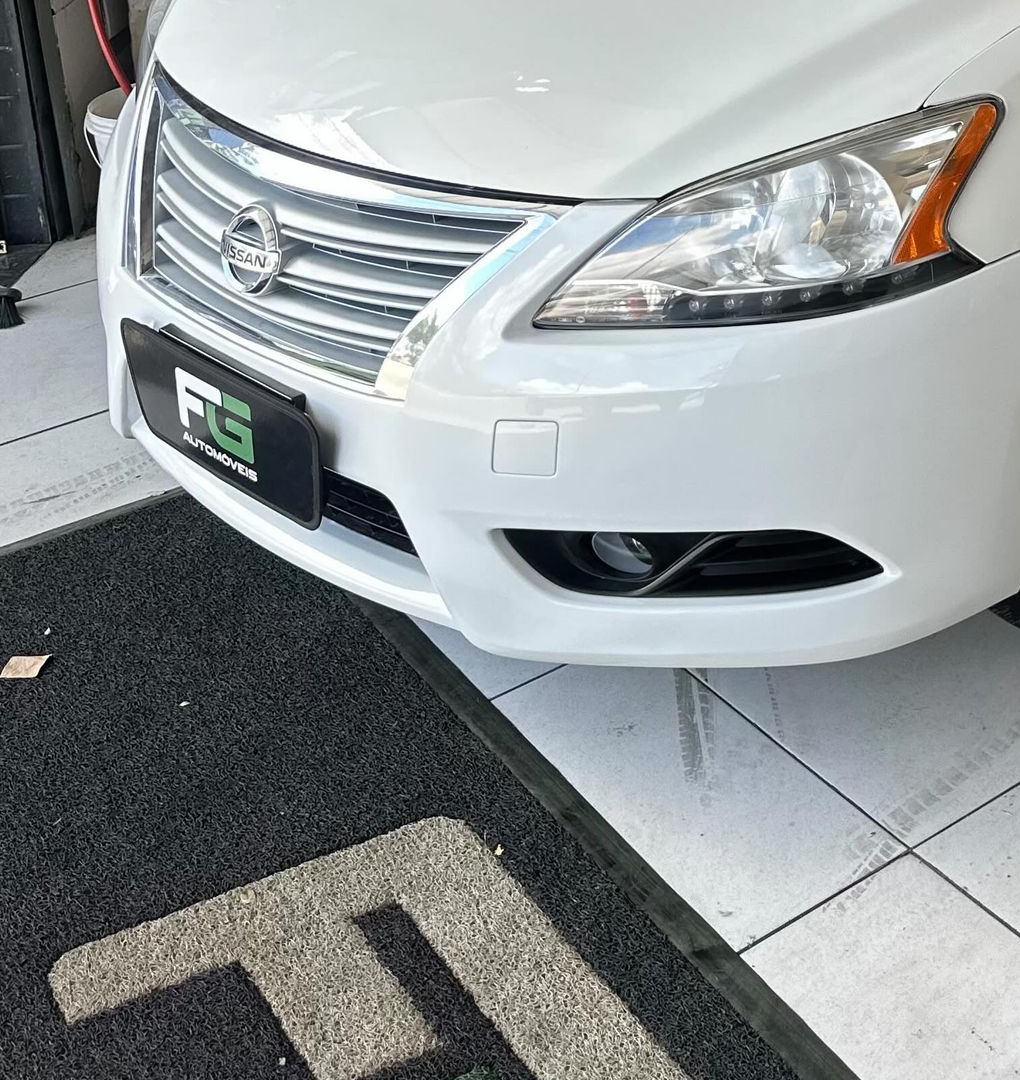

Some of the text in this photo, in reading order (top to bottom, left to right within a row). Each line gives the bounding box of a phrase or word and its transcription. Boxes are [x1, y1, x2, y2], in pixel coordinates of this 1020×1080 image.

[222, 239, 268, 269] NISSAN
[175, 366, 254, 465] FG
[183, 431, 258, 483] AUTOMÓVEIS
